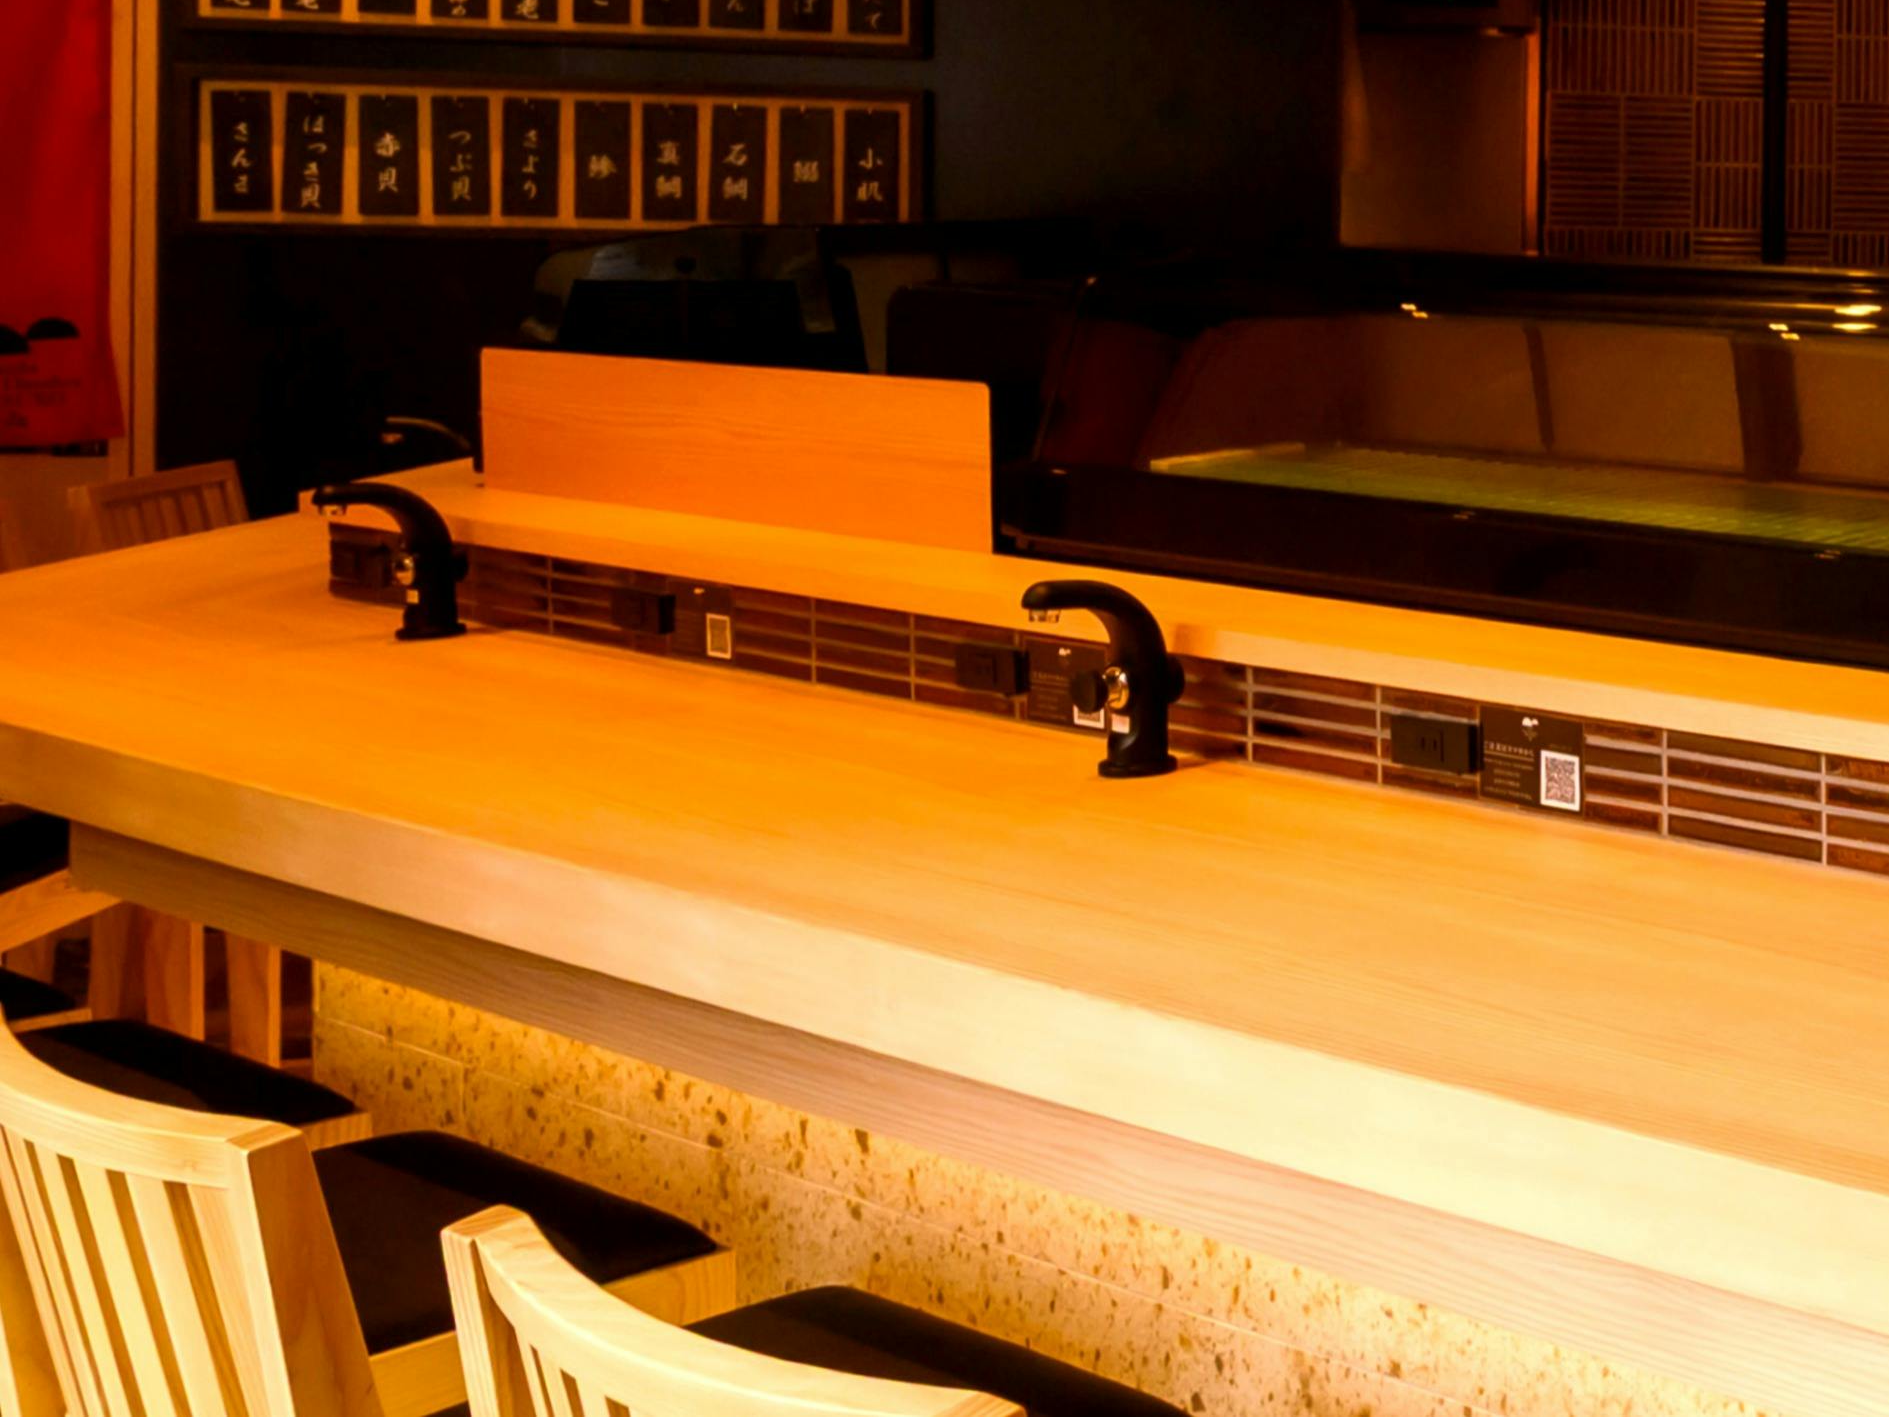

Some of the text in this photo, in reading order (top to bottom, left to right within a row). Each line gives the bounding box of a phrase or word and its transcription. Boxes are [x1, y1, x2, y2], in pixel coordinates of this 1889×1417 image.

[230, 120, 252, 195] さんま
[374, 131, 402, 193] 赤貝
[448, 129, 473, 202] つぶ貝
[520, 127, 540, 200] さより
[855, 146, 884, 203] 小肌
